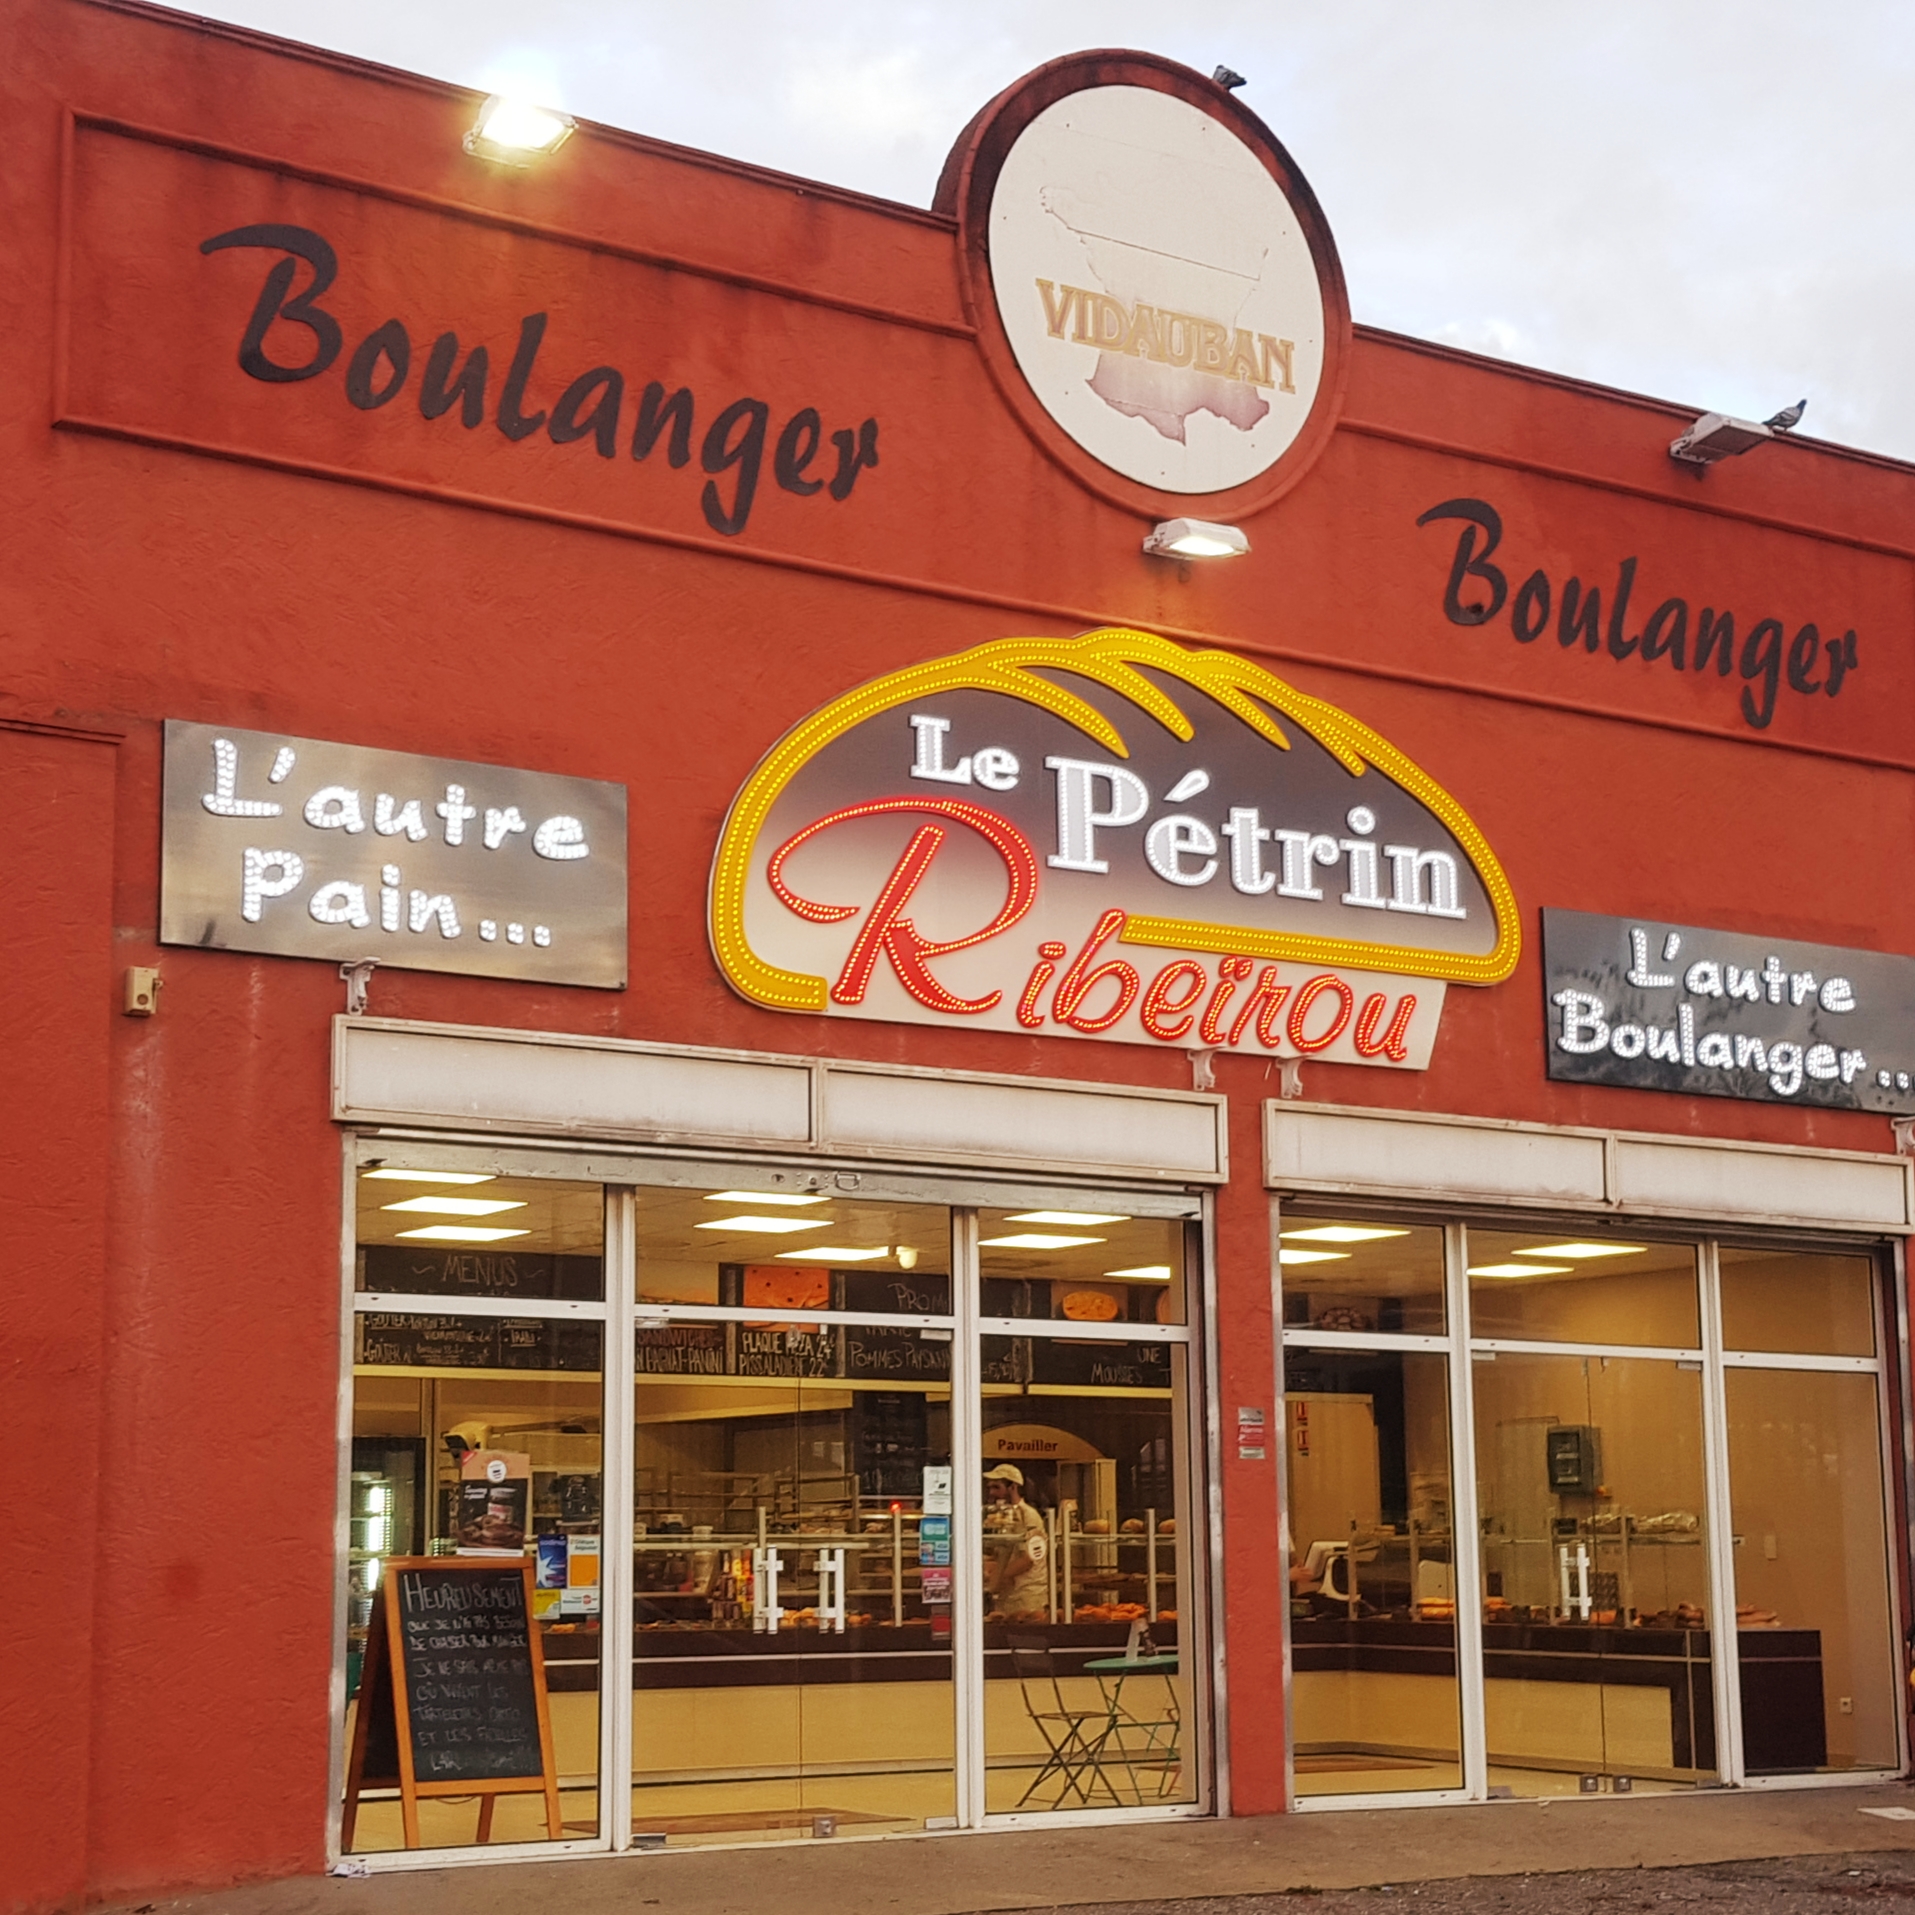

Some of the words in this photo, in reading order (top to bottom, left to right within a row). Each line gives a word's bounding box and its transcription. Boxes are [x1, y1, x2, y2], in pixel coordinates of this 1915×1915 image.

[200, 223, 879, 535] Boulanger
[1035, 277, 1296, 395] VIDAUBAN
[1416, 498, 1857, 729] Boulanger
[203, 737, 590, 860] L'autre
[909, 714, 1021, 790] Le
[1045, 755, 1467, 919] Pétrin
[767, 796, 1418, 1062] Ribeïrou
[1626, 927, 1856, 1013] L'autre
[1553, 988, 1915, 1096] Boulanger..
[440, 1254, 518, 1287] MENUS
[742, 1332, 784, 1354] PLAQUE
[847, 1341, 903, 1369] POMMES
[998, 1439, 1059, 1452] Pavailler
